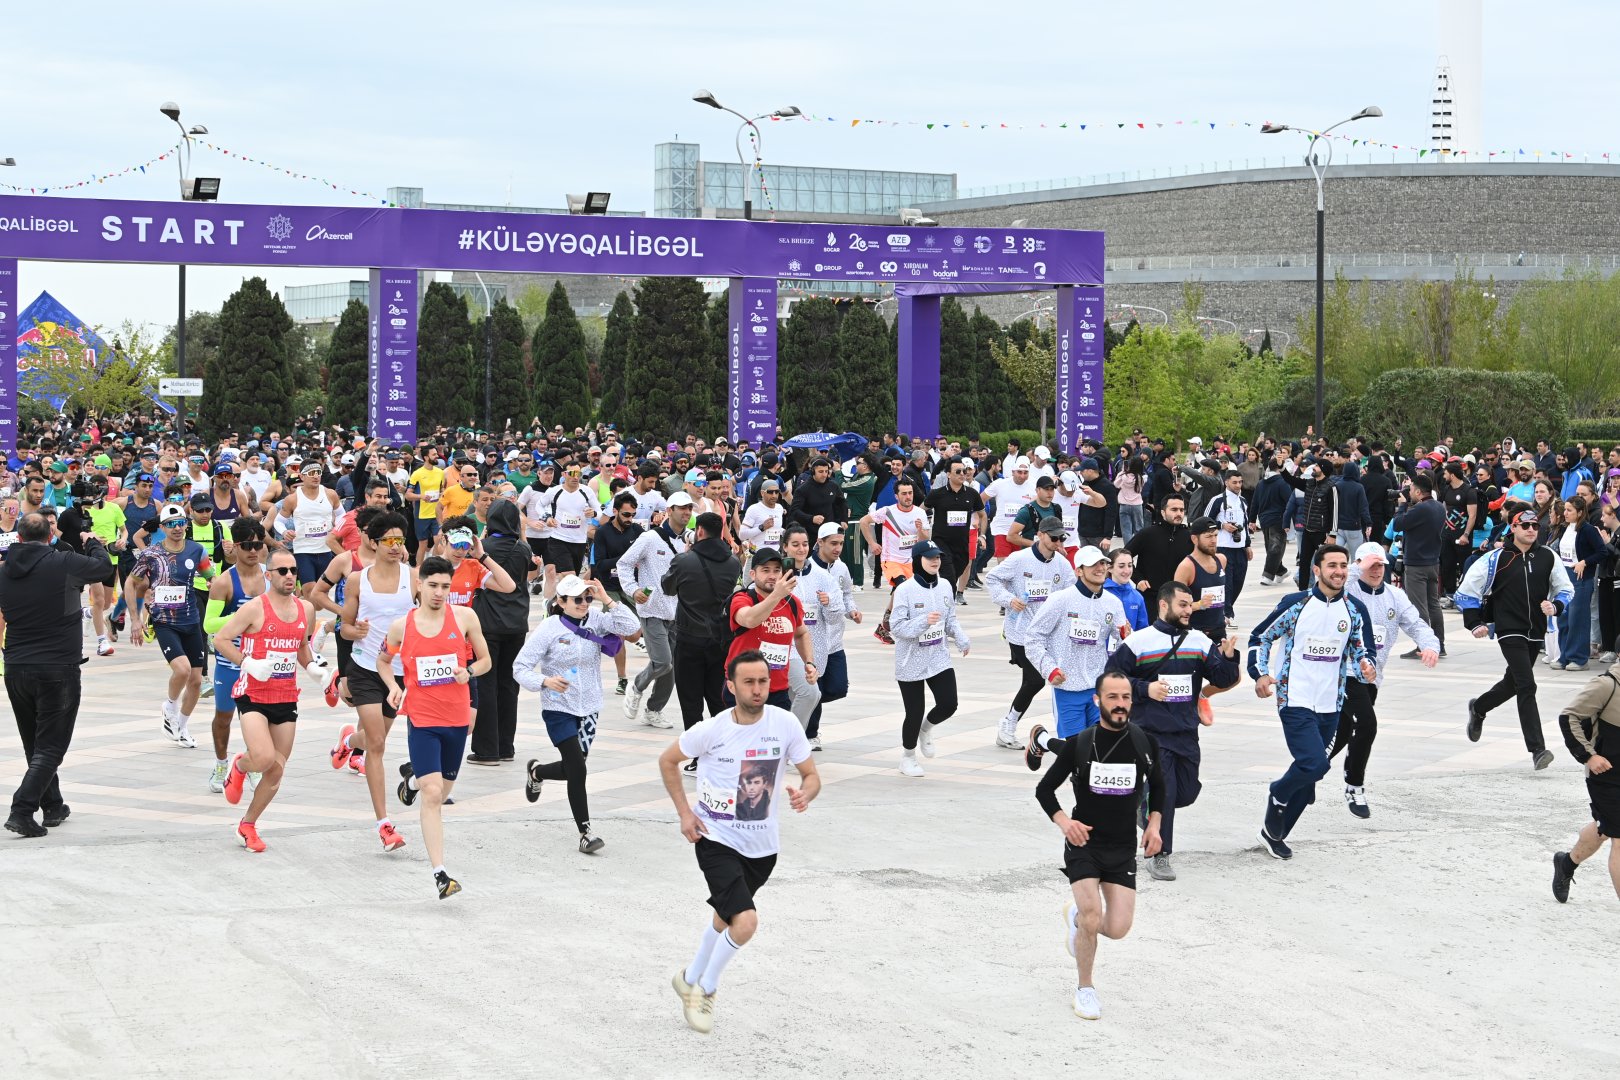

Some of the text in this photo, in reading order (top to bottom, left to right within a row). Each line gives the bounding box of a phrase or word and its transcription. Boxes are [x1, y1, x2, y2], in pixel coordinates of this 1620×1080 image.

[0, 215, 79, 233] QALİBGƏL
[101, 214, 245, 246] START
[323, 232, 353, 241] Azercell
[457, 225, 705, 258] #KÜLƏYƏQALİBGƏL
[891, 236, 907, 244] AZE
[880, 261, 898, 273] GO
[1028, 588, 1049, 596] 16892
[804, 611, 815, 619] 02
[923, 629, 943, 641] 16891
[1074, 628, 1097, 638] 16898
[264, 636, 302, 649] TÜRKİY
[1308, 645, 1337, 655] 16897
[424, 666, 452, 678] 3700
[1167, 685, 1190, 694] 6893
[1093, 775, 1132, 787] 24455
